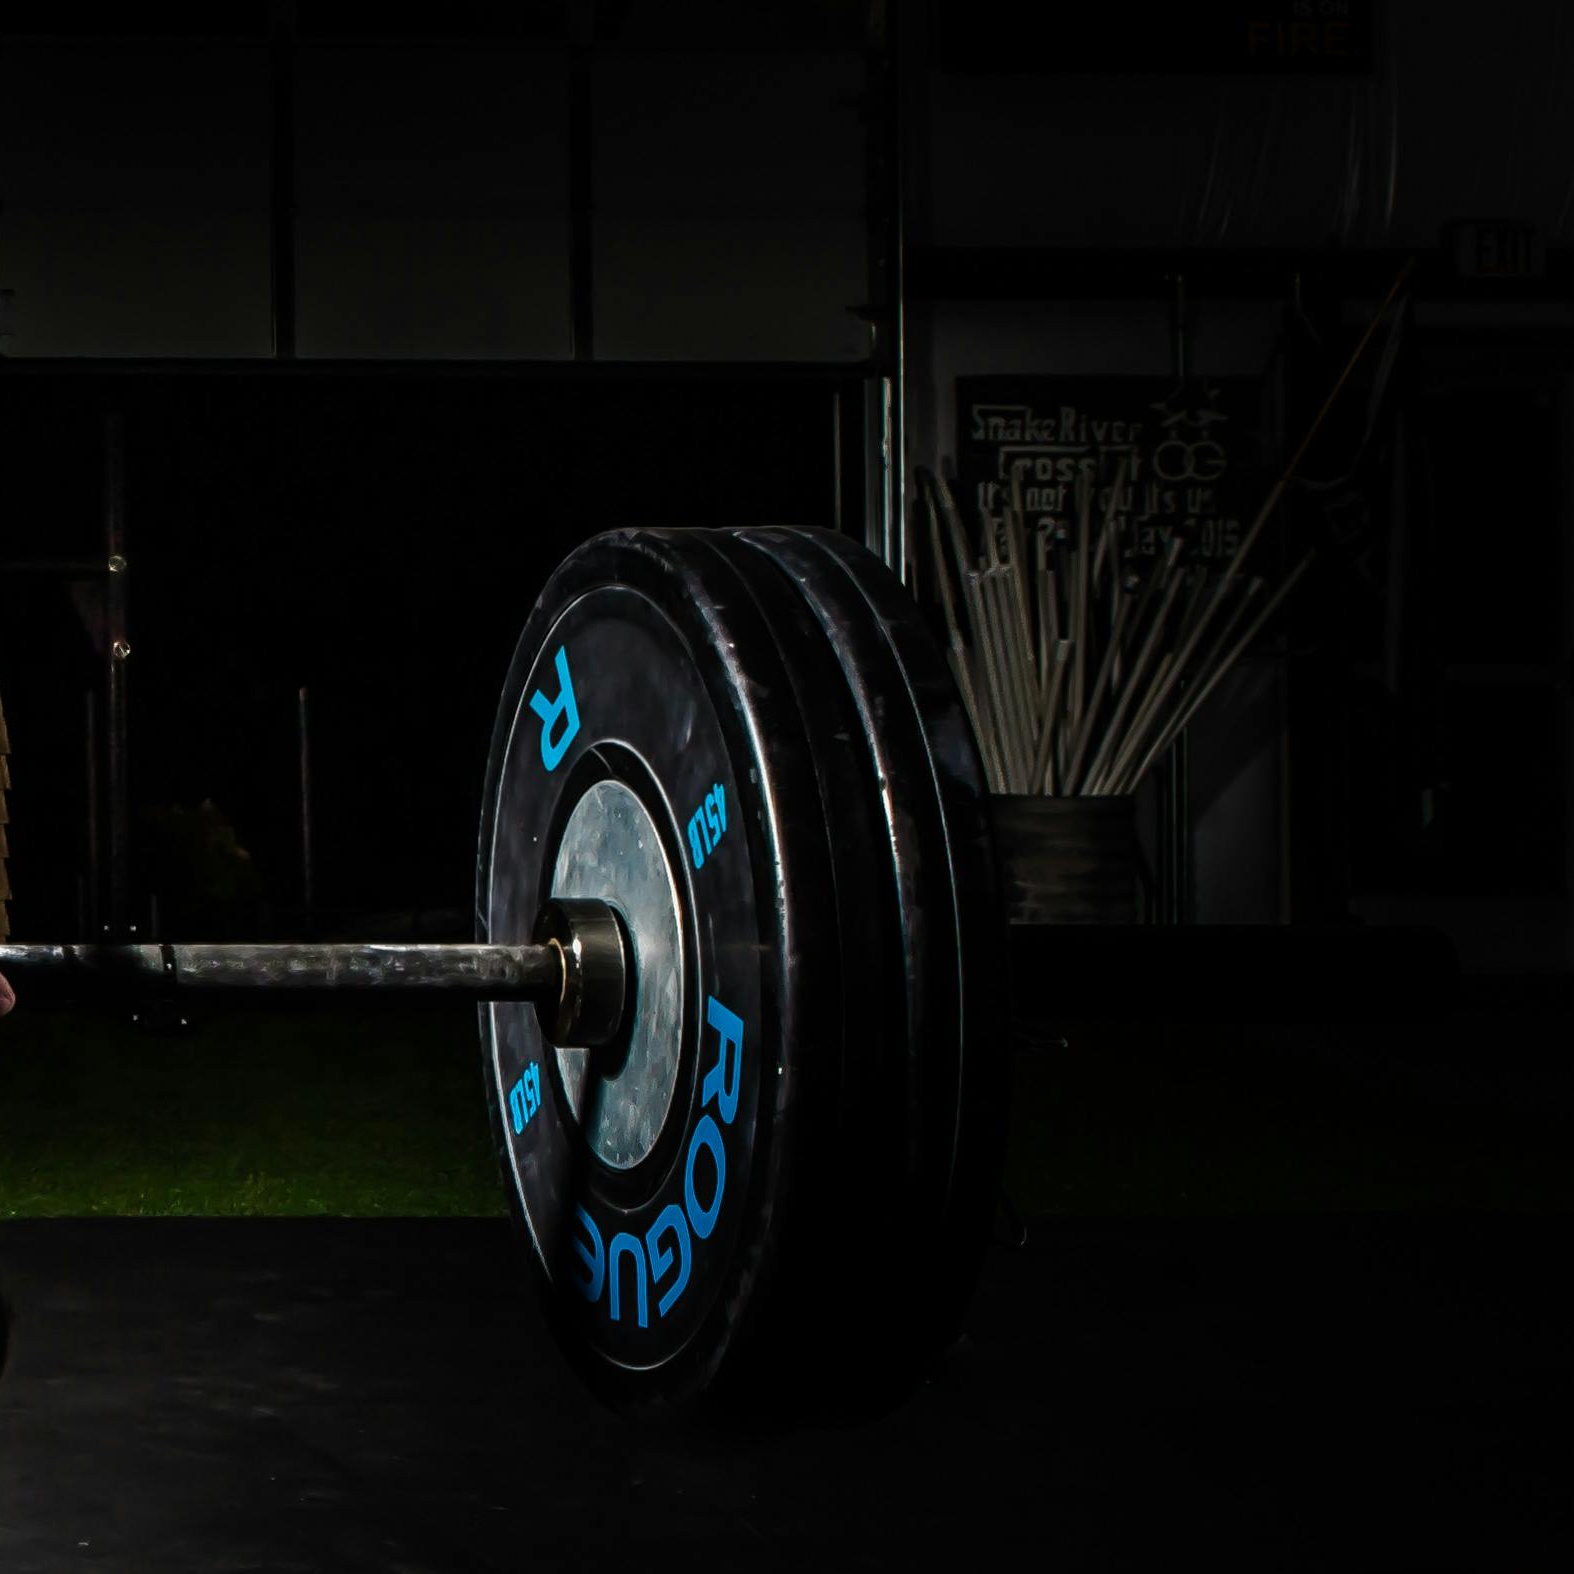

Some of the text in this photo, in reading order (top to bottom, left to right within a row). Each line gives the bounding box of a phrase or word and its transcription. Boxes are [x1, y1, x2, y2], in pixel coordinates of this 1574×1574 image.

[685, 783, 729, 870] 45LB
[509, 1061, 541, 1135] 45LB
[572, 993, 748, 1329] ROGUE
